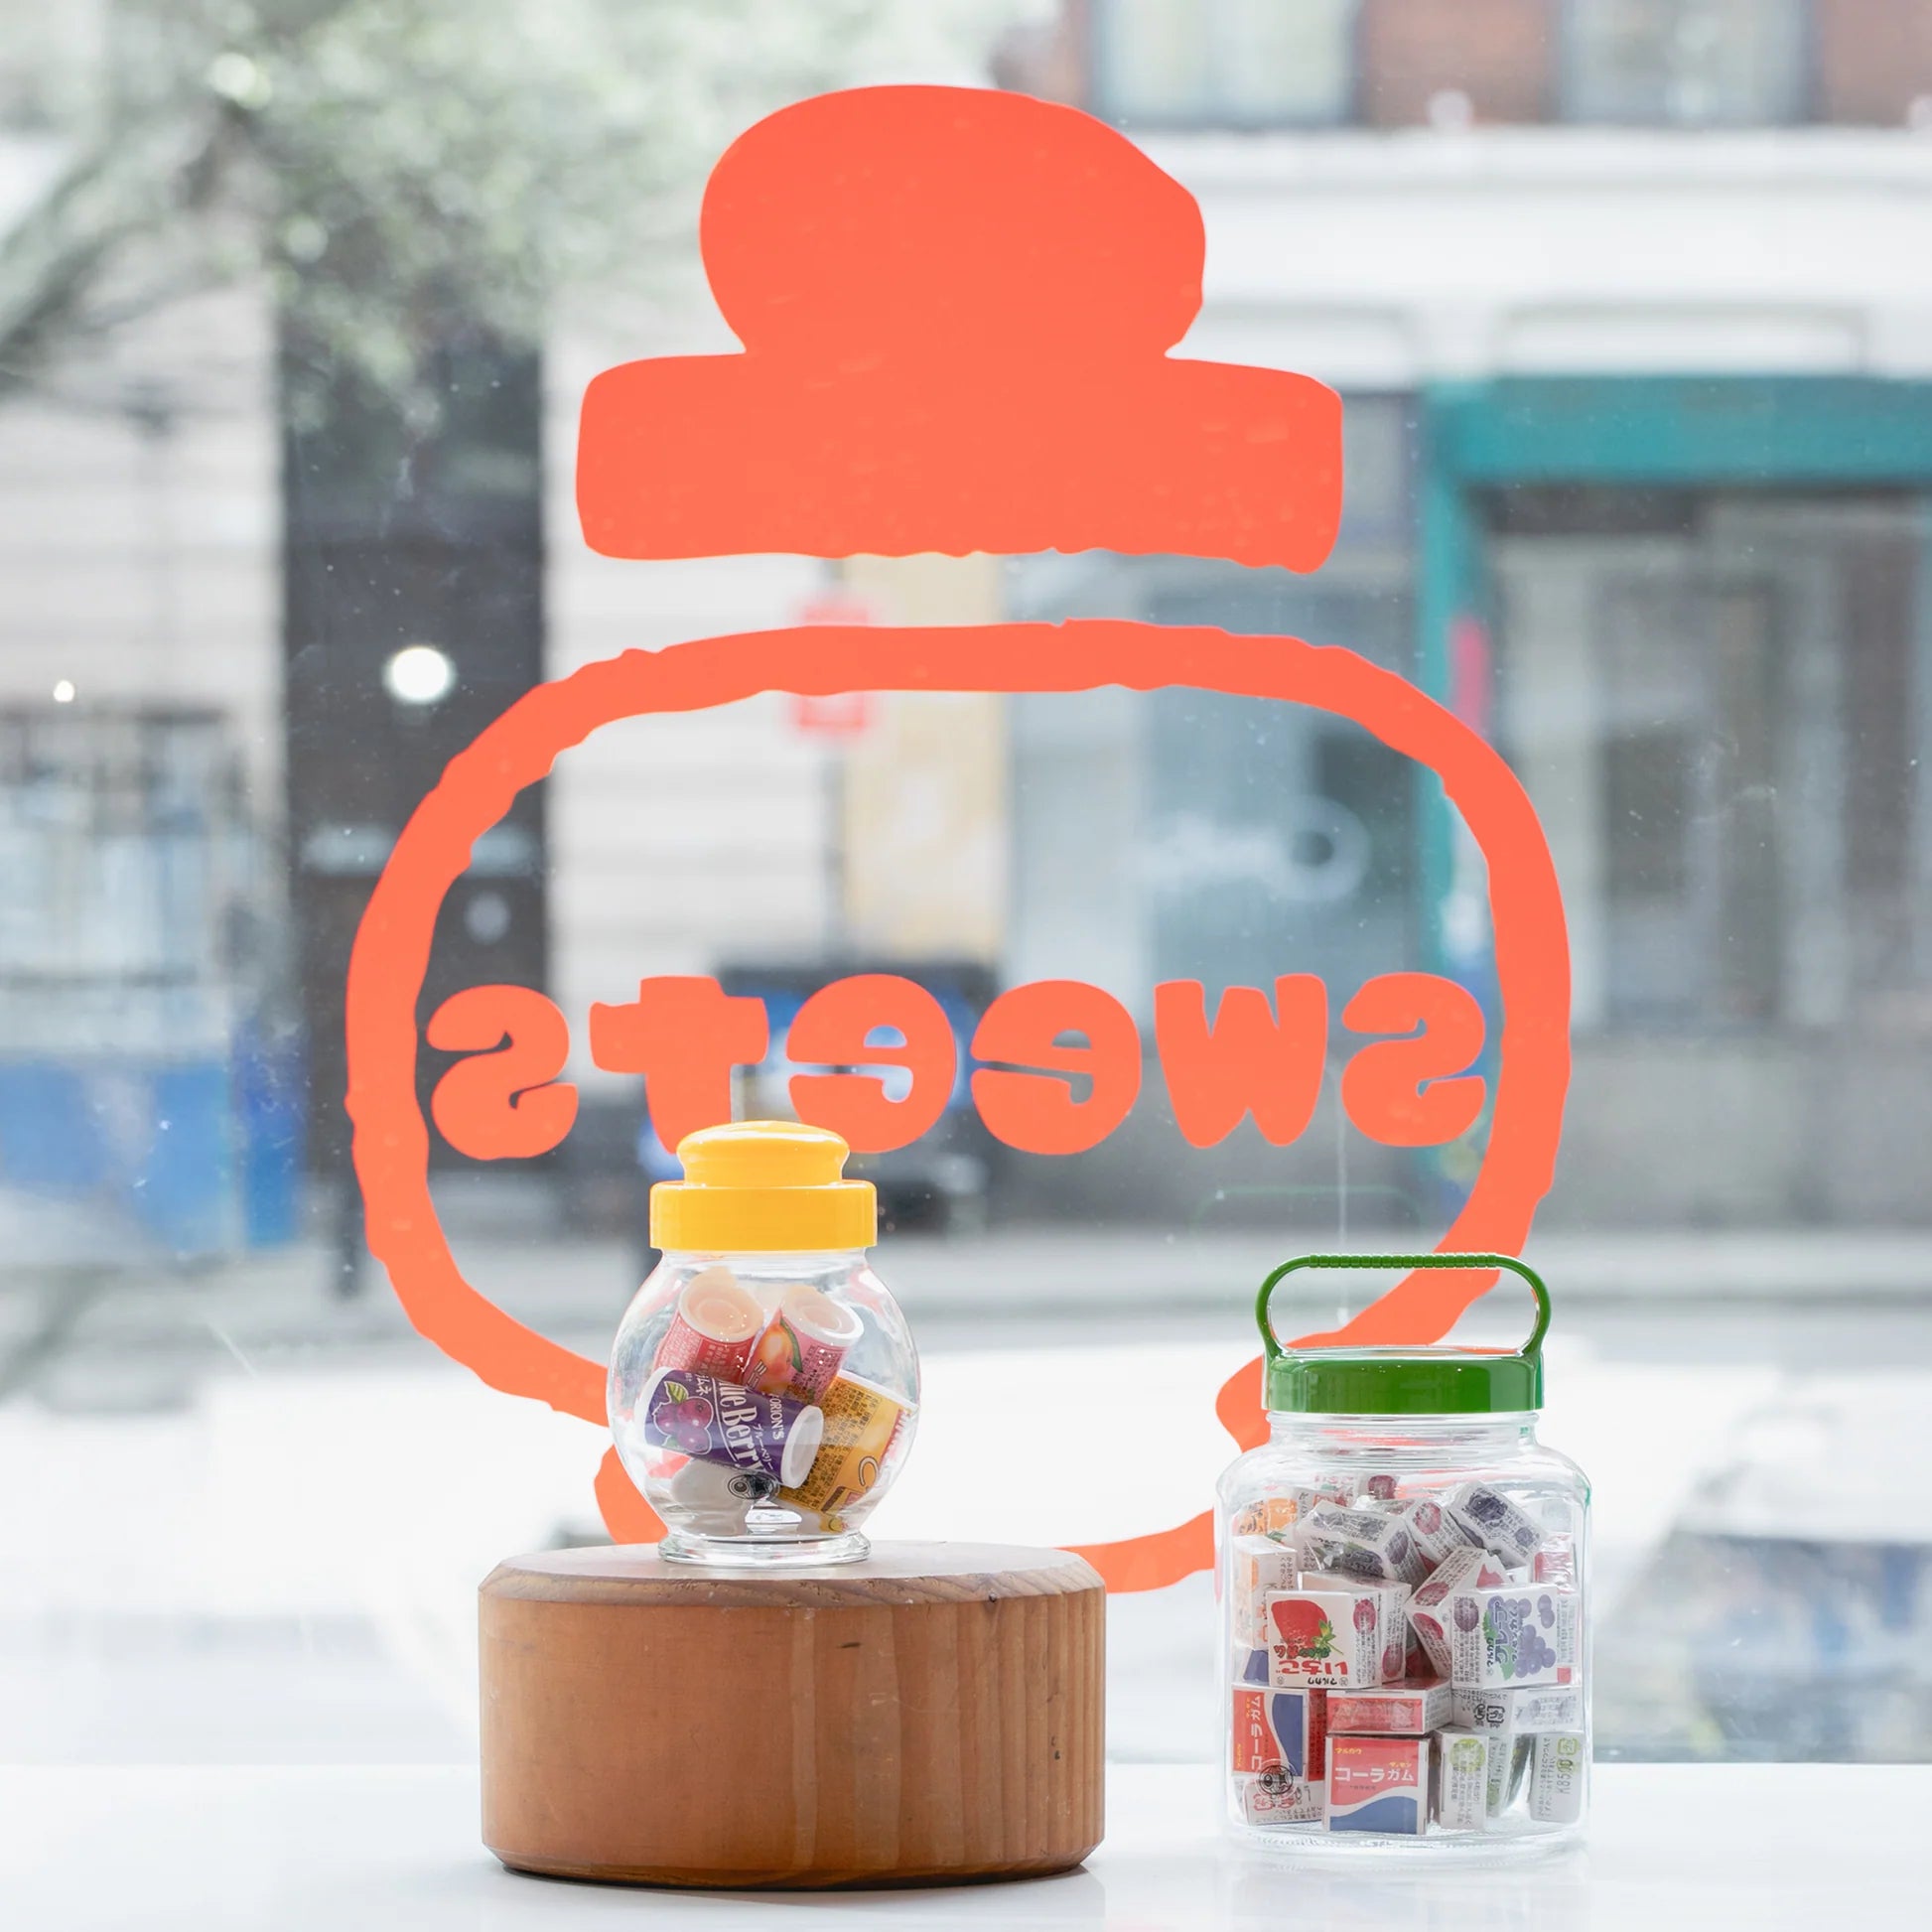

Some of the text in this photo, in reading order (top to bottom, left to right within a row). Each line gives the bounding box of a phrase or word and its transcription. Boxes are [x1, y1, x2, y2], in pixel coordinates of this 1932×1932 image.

[722, 1406, 767, 1473] Berry
[769, 1396, 784, 1440] ORION'S
[753, 1423, 774, 1470] ブルーベリー
[1276, 1660, 1348, 1676] いちご
[1307, 1677, 1338, 1686] マルカワ
